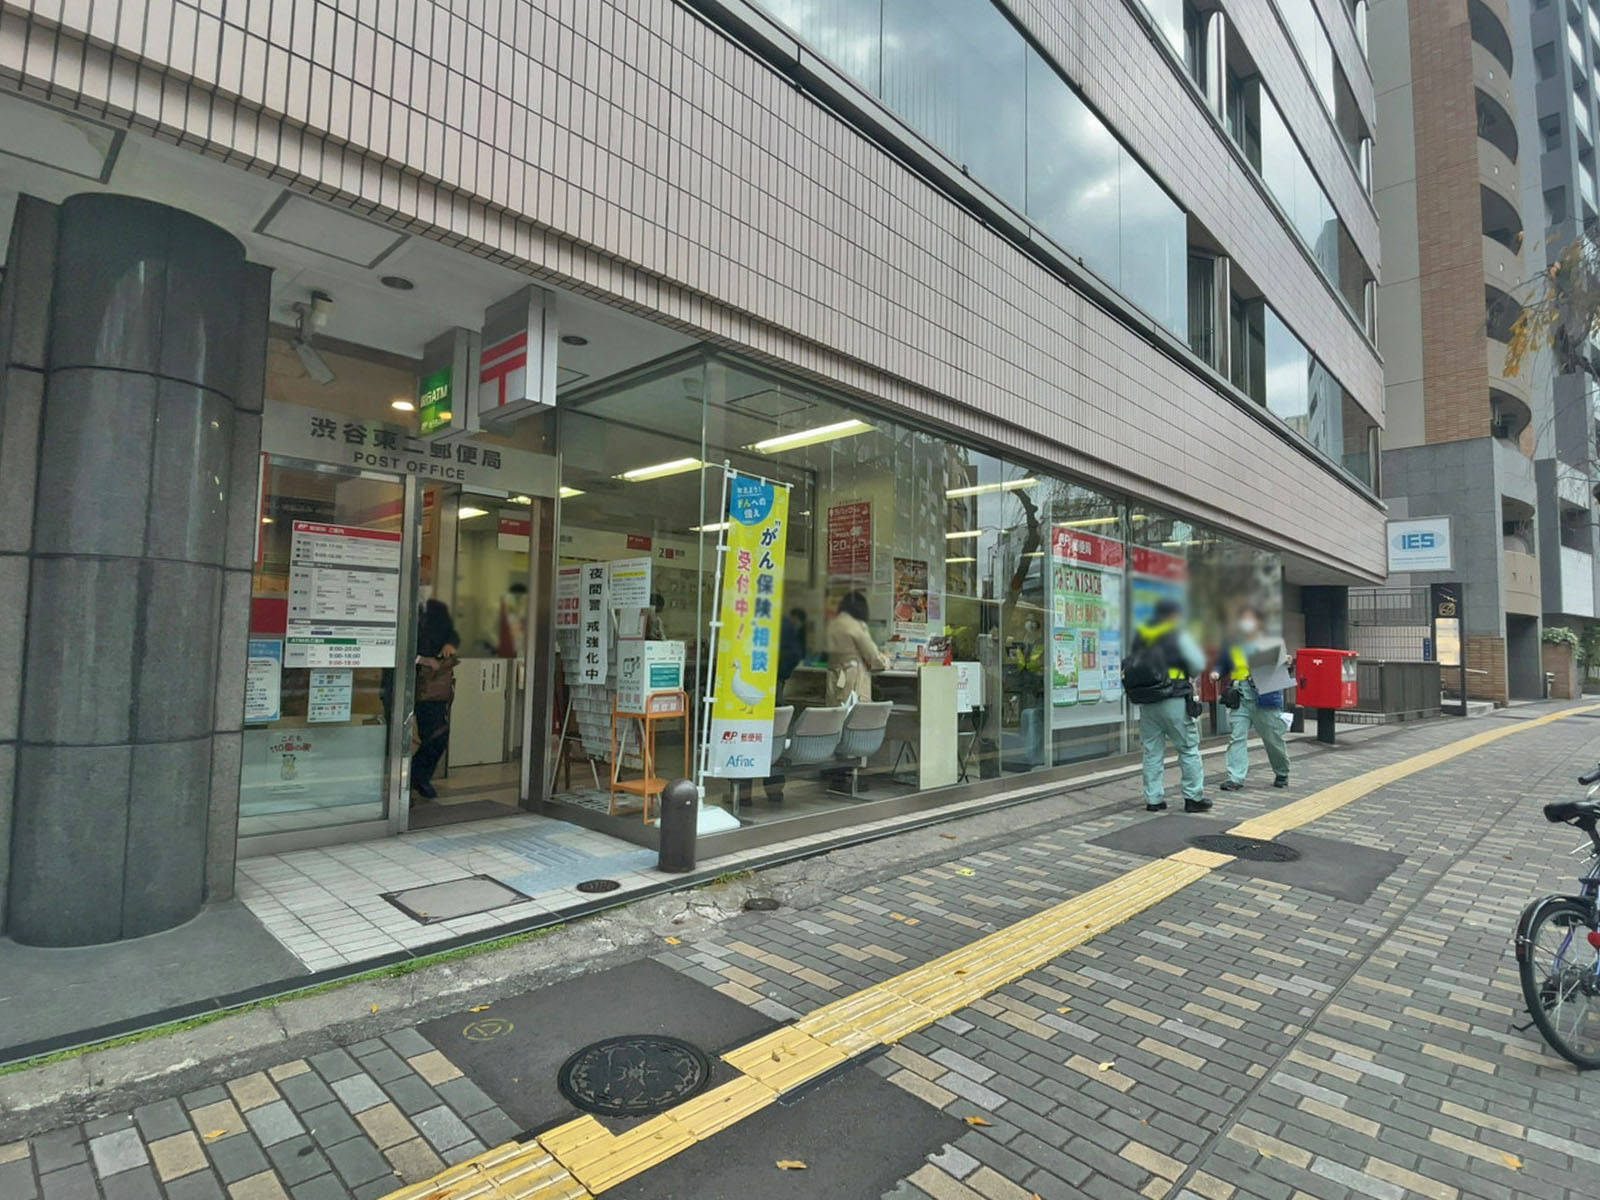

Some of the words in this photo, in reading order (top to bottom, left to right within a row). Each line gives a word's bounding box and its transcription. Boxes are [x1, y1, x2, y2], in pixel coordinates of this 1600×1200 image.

[310, 416, 502, 470] 渋谷東二郵便局
[353, 451, 400, 470] POST
[406, 460, 466, 481] OFFICE
[1401, 532, 1435, 550] IES
[733, 549, 752, 640] 受付中!
[726, 754, 755, 768] Aflac
